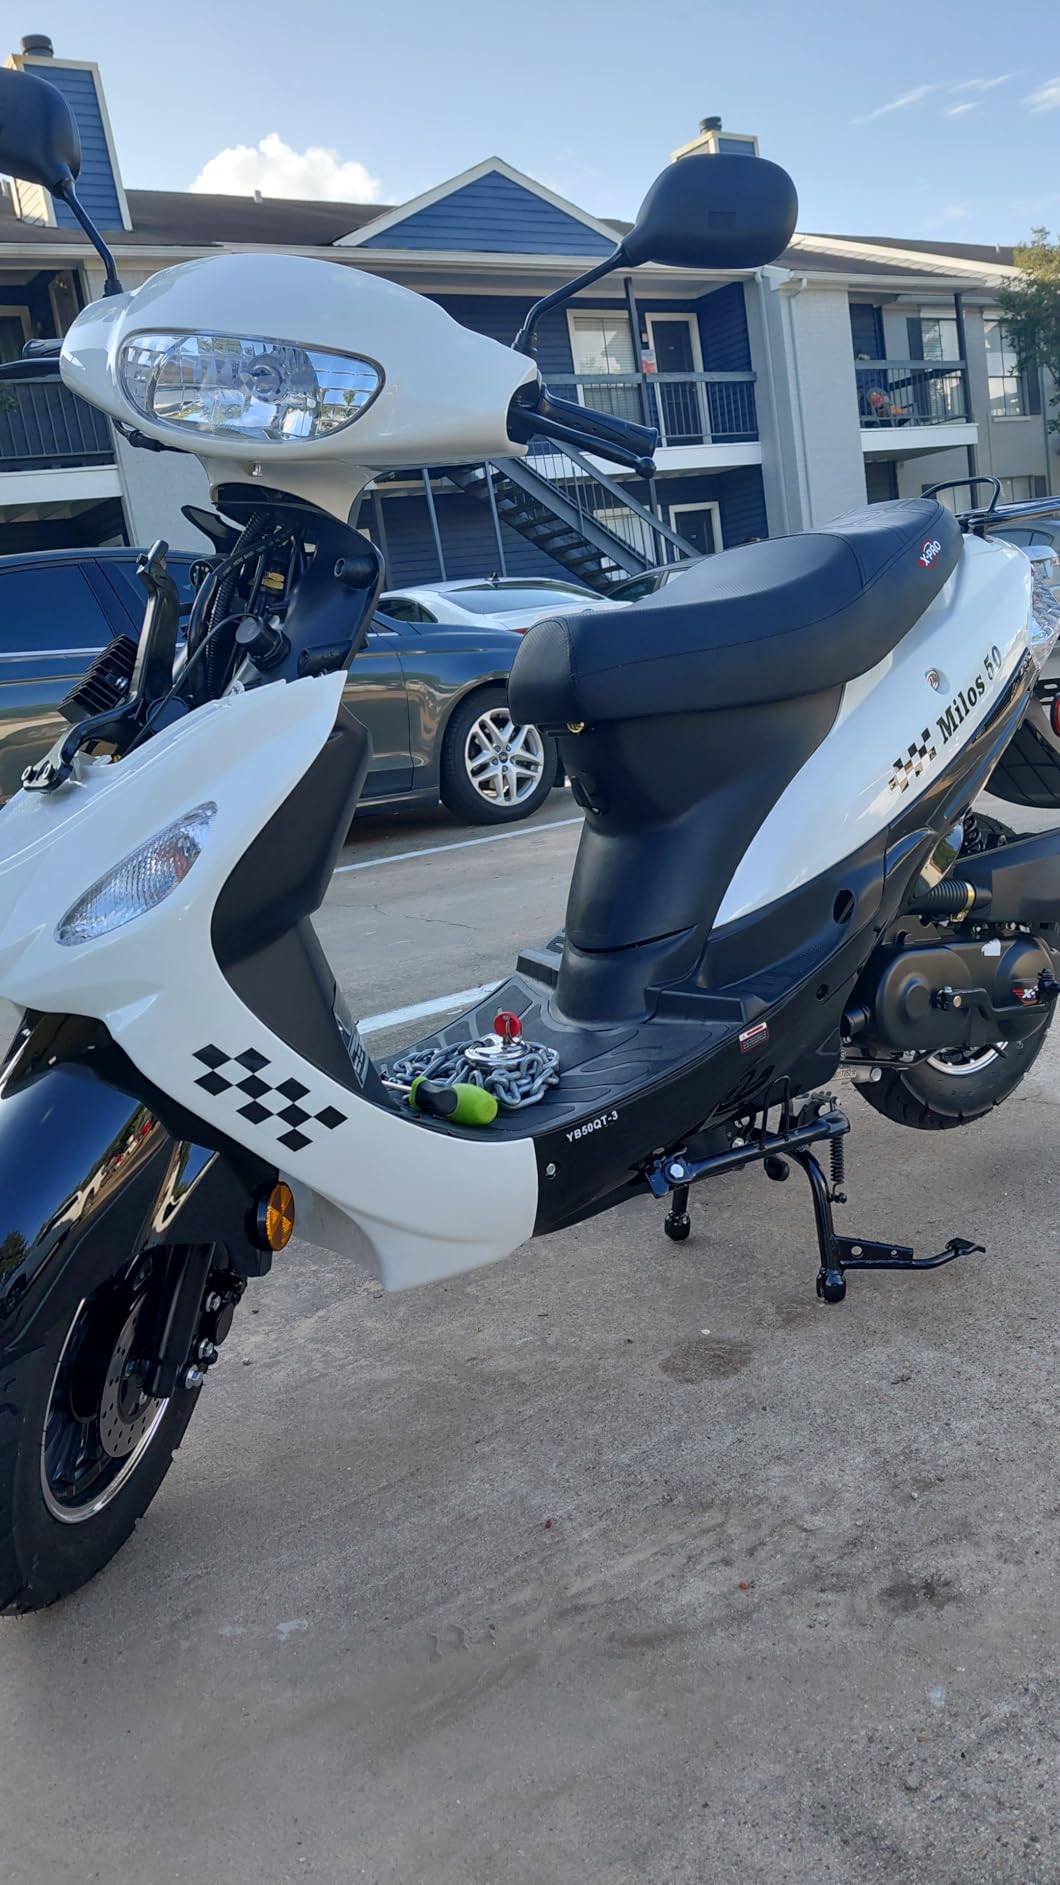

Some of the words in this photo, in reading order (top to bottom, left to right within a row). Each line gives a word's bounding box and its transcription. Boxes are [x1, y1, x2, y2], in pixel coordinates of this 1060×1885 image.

[936, 674, 985, 744] Milos
[983, 645, 1002, 681] 50
[565, 1110, 619, 1142] YB50QT-3
